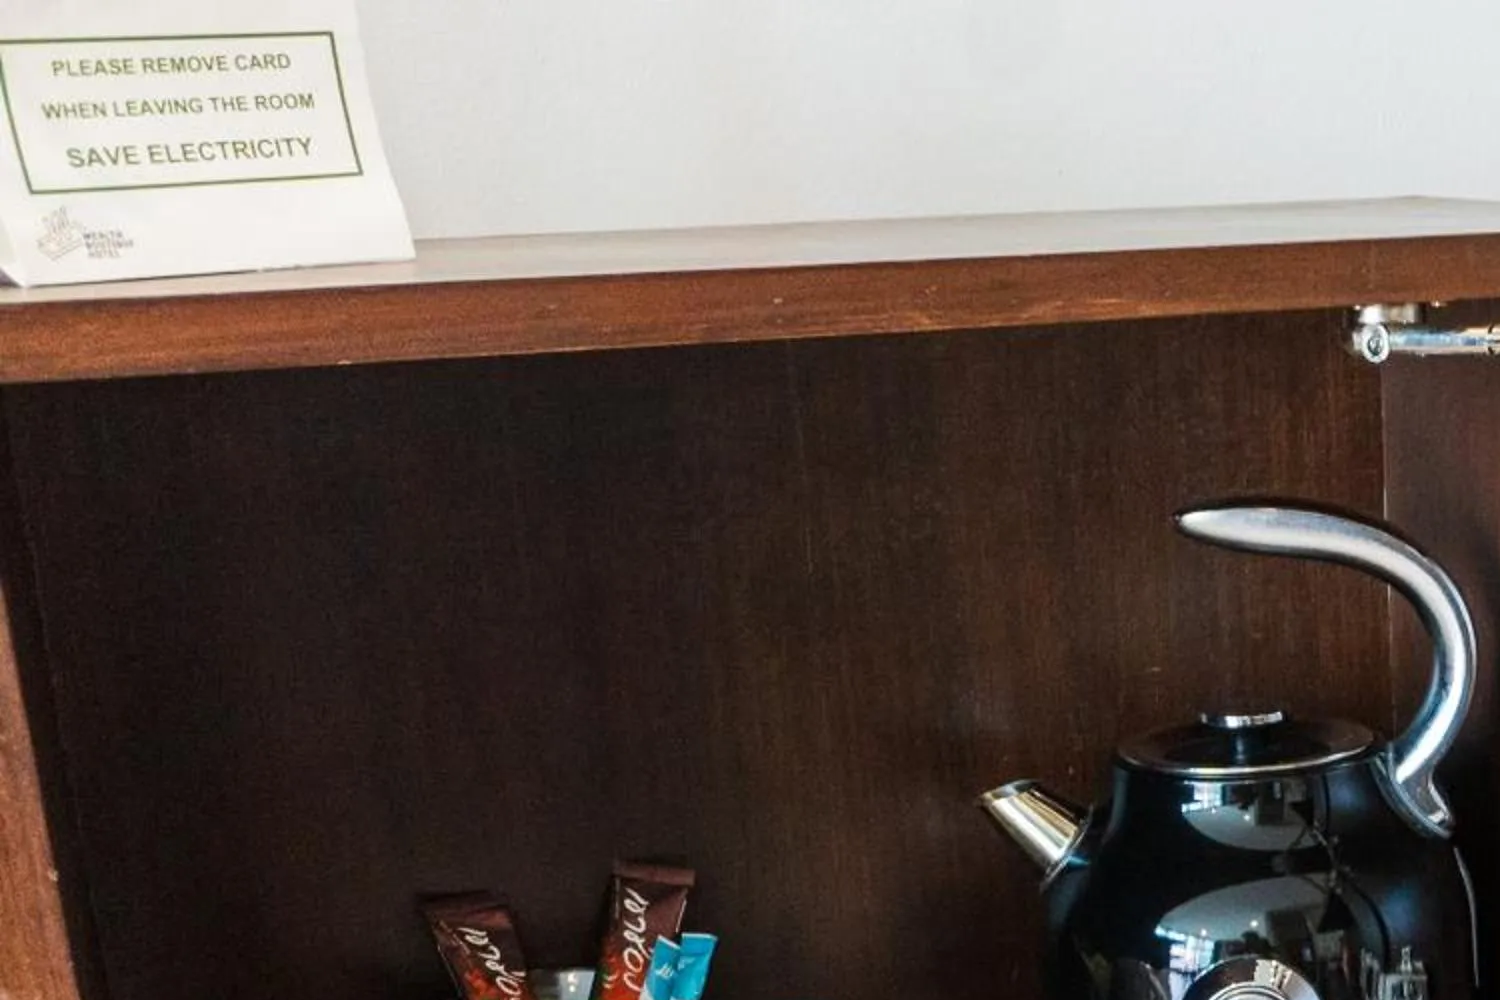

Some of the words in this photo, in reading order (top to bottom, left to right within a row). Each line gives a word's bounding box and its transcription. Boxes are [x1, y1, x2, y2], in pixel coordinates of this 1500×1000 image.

[51, 59, 135, 77] PLEASE
[142, 55, 229, 74] REMOVE
[235, 53, 291, 71] CARD
[41, 102, 107, 120] WHEN
[113, 98, 204, 118] LEAVING
[209, 96, 249, 112] THE
[254, 93, 315, 110] ROOM
[66, 146, 141, 168] SAVE
[147, 137, 312, 164] ELECTRICITY
